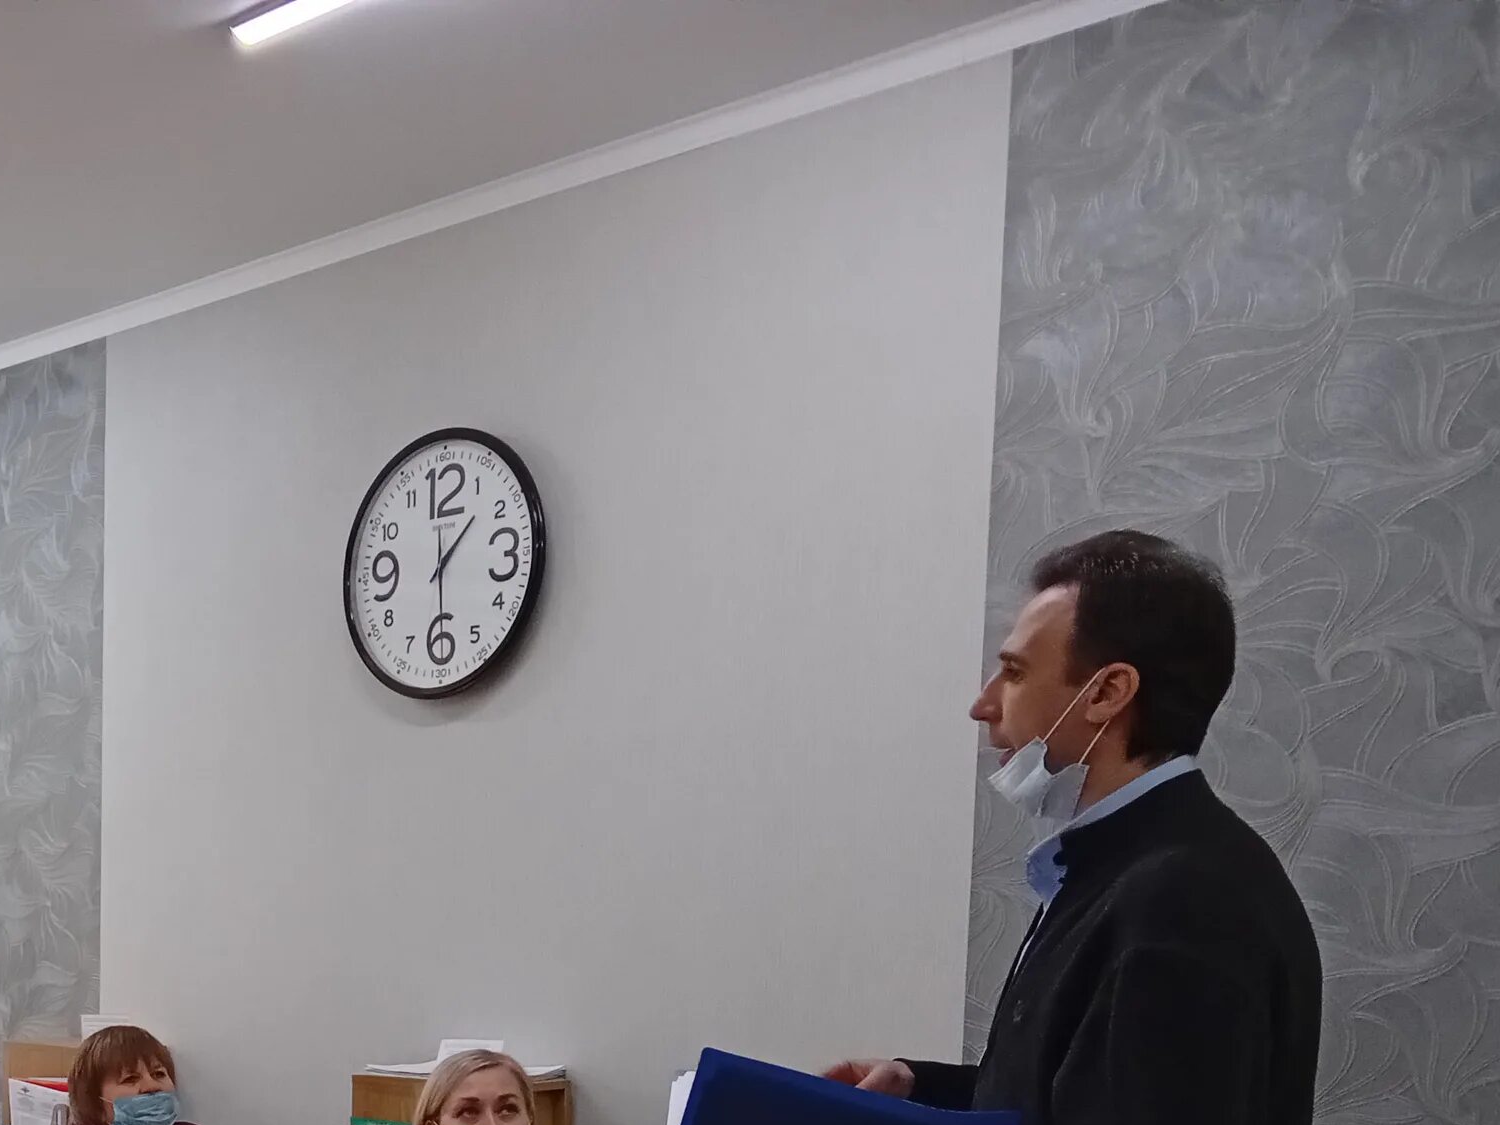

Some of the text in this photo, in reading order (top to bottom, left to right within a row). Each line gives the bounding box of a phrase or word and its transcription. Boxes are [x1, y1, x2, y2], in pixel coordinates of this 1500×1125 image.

[440, 451, 451, 462] 60
[425, 463, 465, 520] 12
[475, 475, 480, 495] 1
[406, 489, 417, 509] 11
[494, 499, 506, 520] 2
[382, 522, 398, 541] 10
[488, 527, 520, 582] 3
[372, 550, 400, 602] 9
[492, 591, 505, 610] 4
[384, 609, 394, 627] 8
[426, 612, 456, 666] 6
[470, 625, 481, 644] 5
[406, 635, 415, 654] 7
[435, 668, 447, 678] 30
